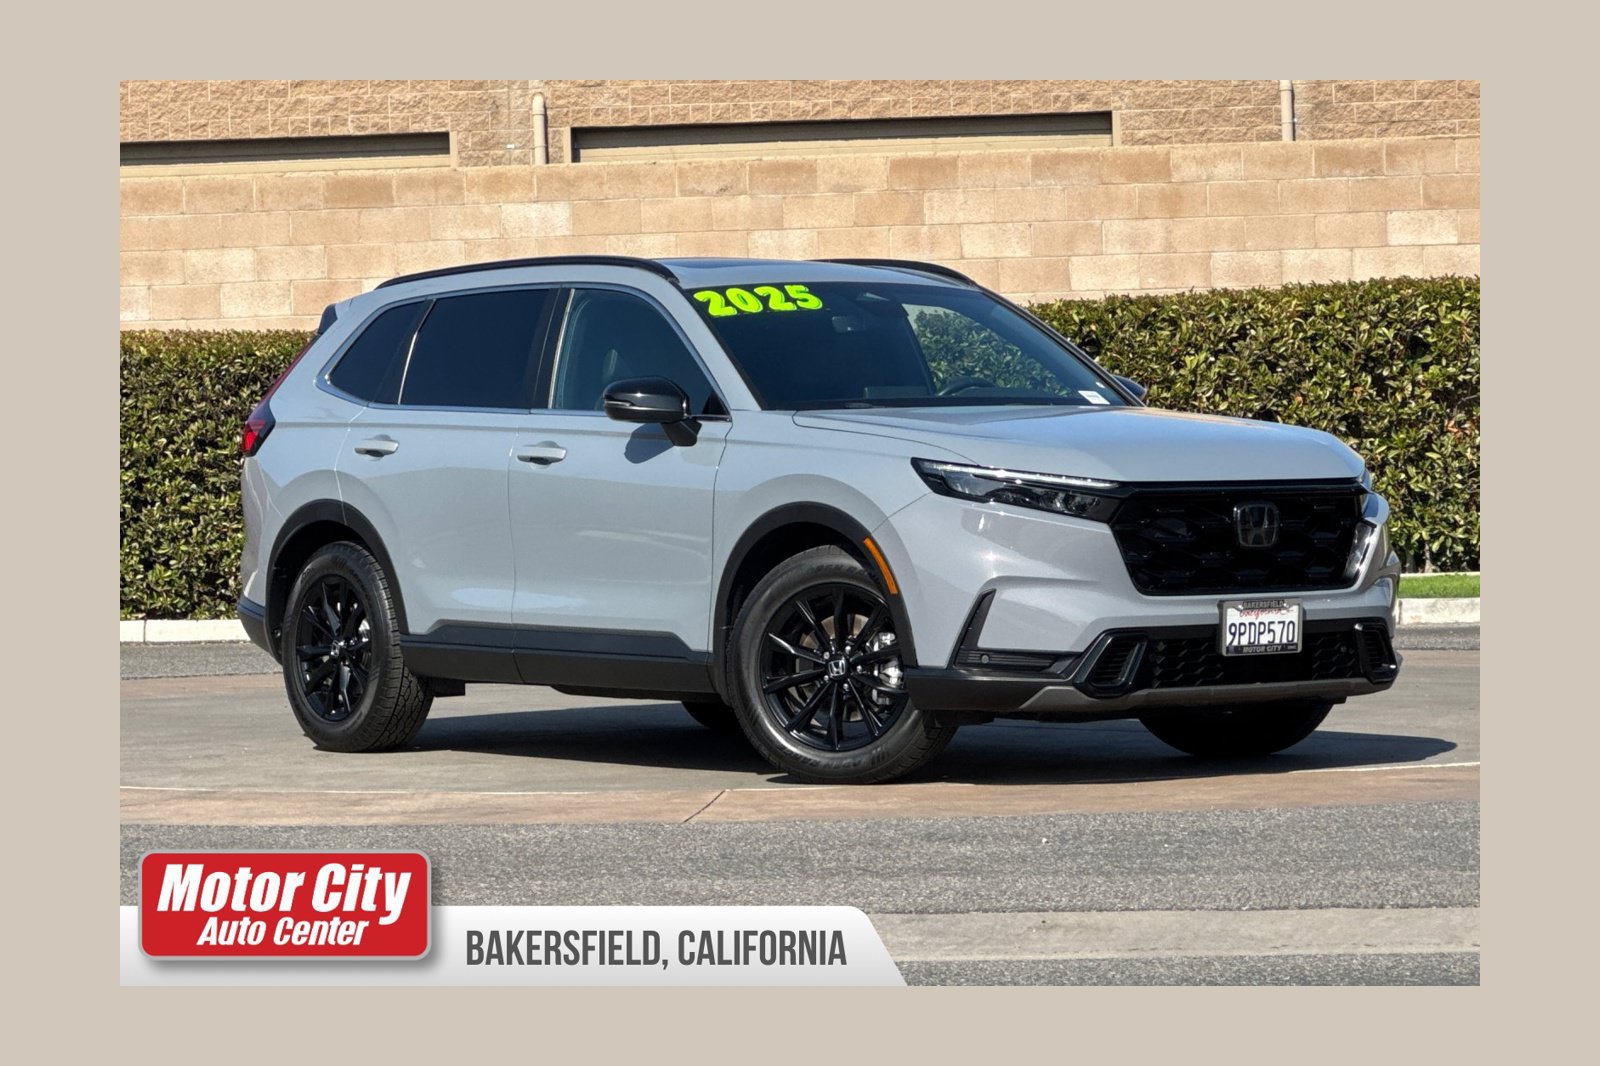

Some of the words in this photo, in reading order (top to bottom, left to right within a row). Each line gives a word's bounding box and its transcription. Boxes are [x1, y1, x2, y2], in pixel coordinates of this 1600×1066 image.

[693, 284, 823, 317] 2025
[1243, 600, 1284, 608] BAKERSFIELD
[1228, 621, 1295, 645] 9PDP570
